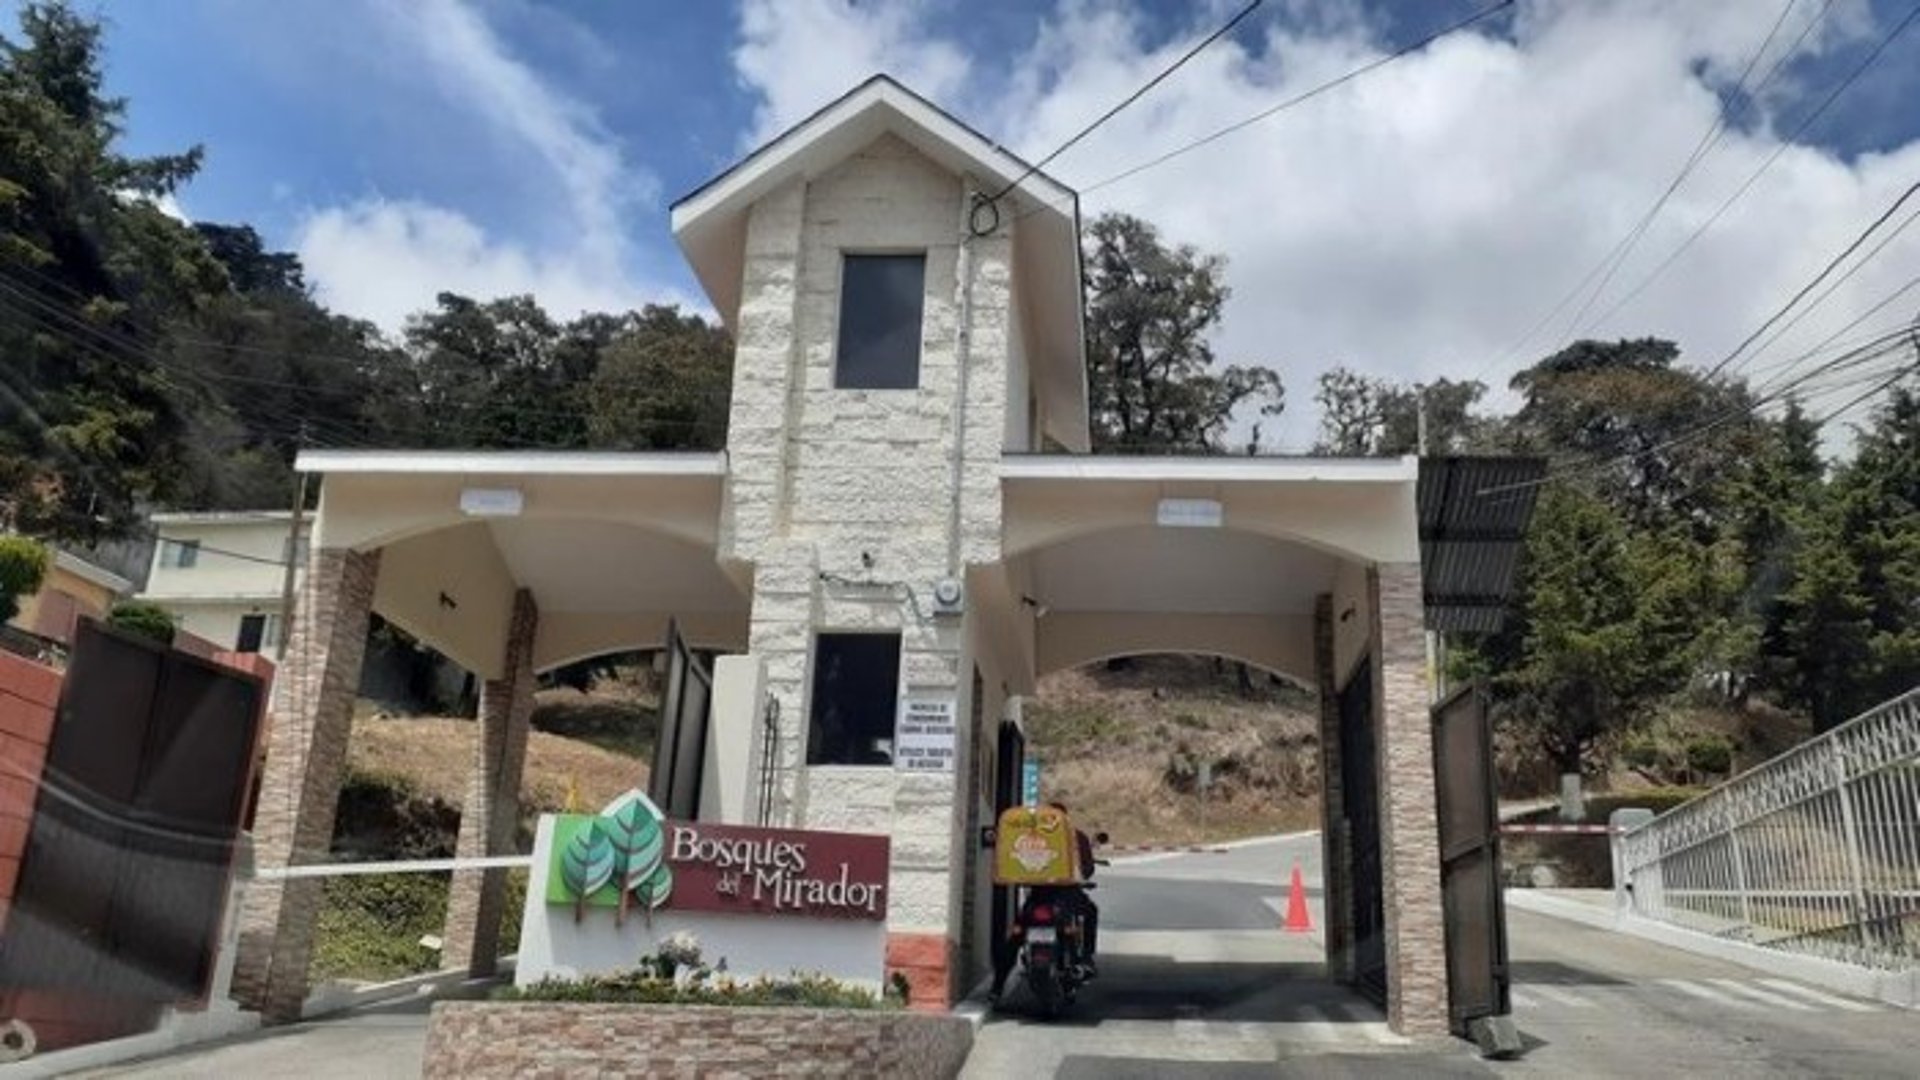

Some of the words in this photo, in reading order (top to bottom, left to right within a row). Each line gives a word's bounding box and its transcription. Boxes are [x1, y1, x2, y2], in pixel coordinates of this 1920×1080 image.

[670, 826, 805, 874] Bosques
[717, 873, 740, 895] del
[752, 862, 882, 912] Mirador
